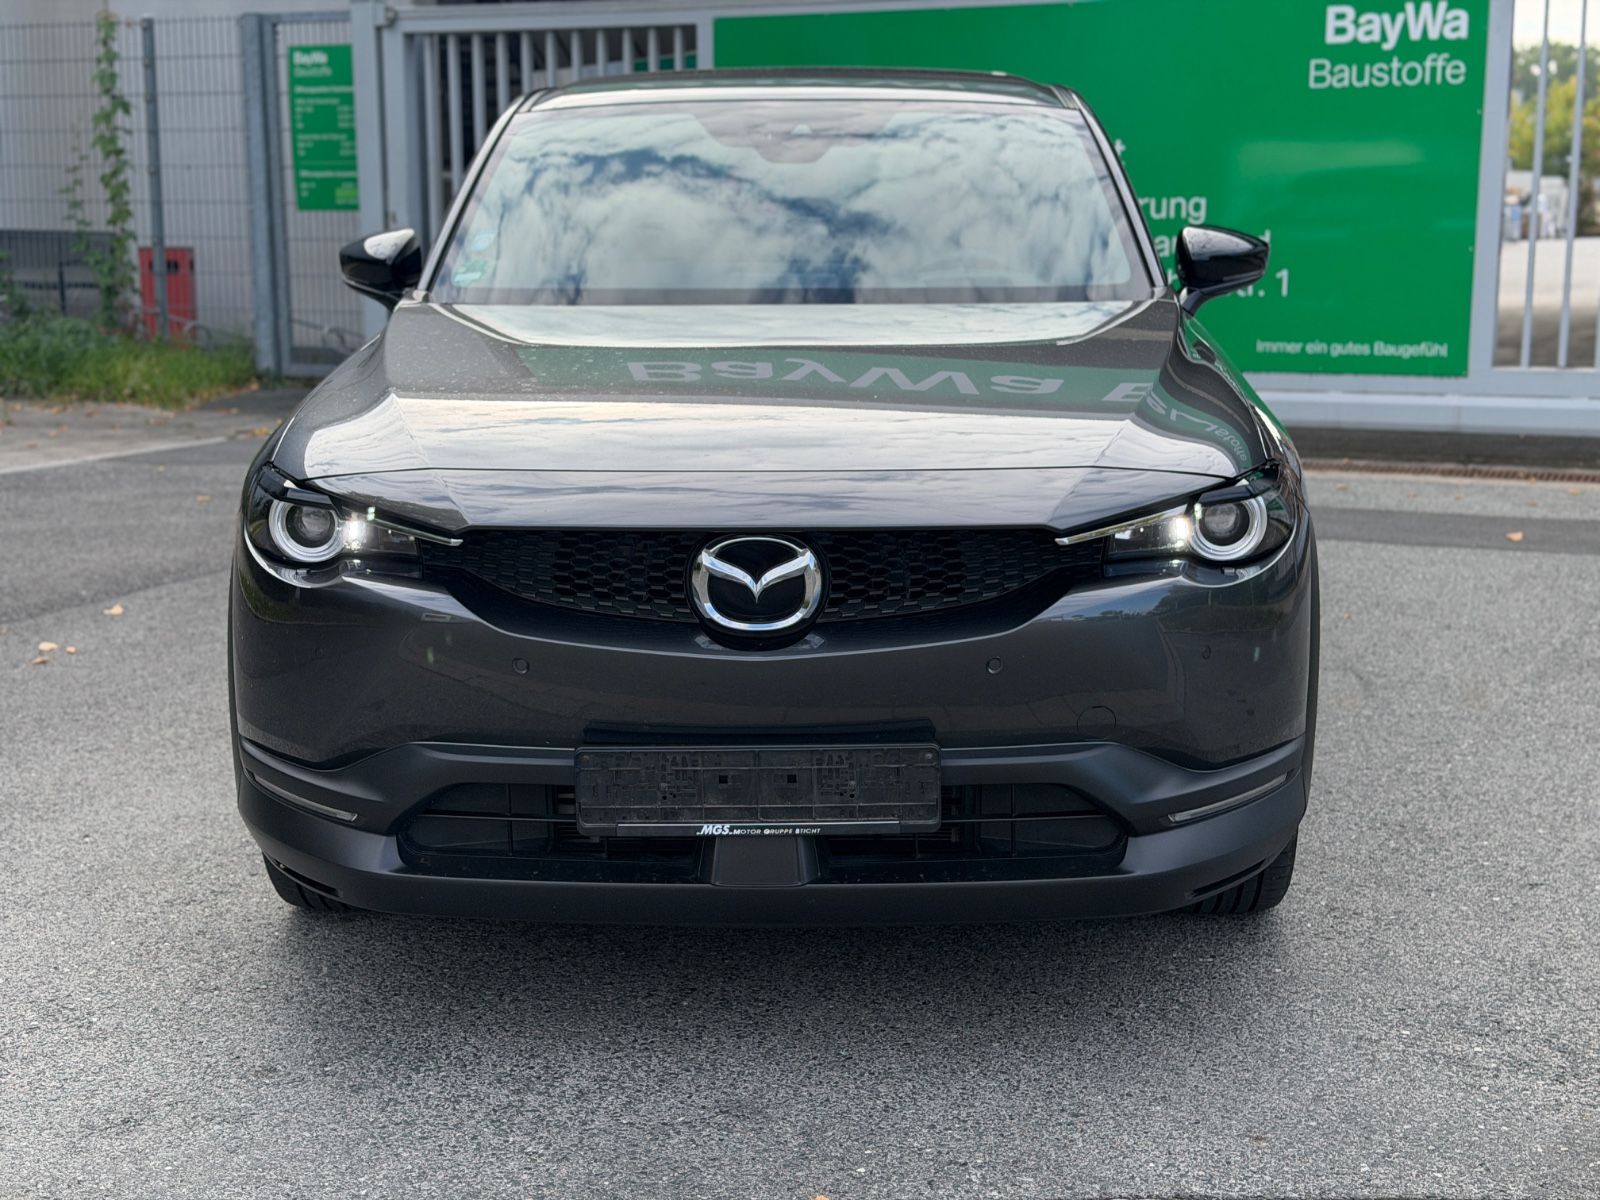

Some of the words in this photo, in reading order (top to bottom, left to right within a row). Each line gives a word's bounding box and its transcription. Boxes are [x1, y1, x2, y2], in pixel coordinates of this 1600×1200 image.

[1325, 1, 1469, 50] BayWa
[1308, 53, 1467, 89] Baustoffe
[1256, 339, 1303, 353] Immer
[1305, 340, 1328, 355] ein
[1330, 341, 1371, 357] gutes
[1373, 340, 1448, 359] Baugefühl
